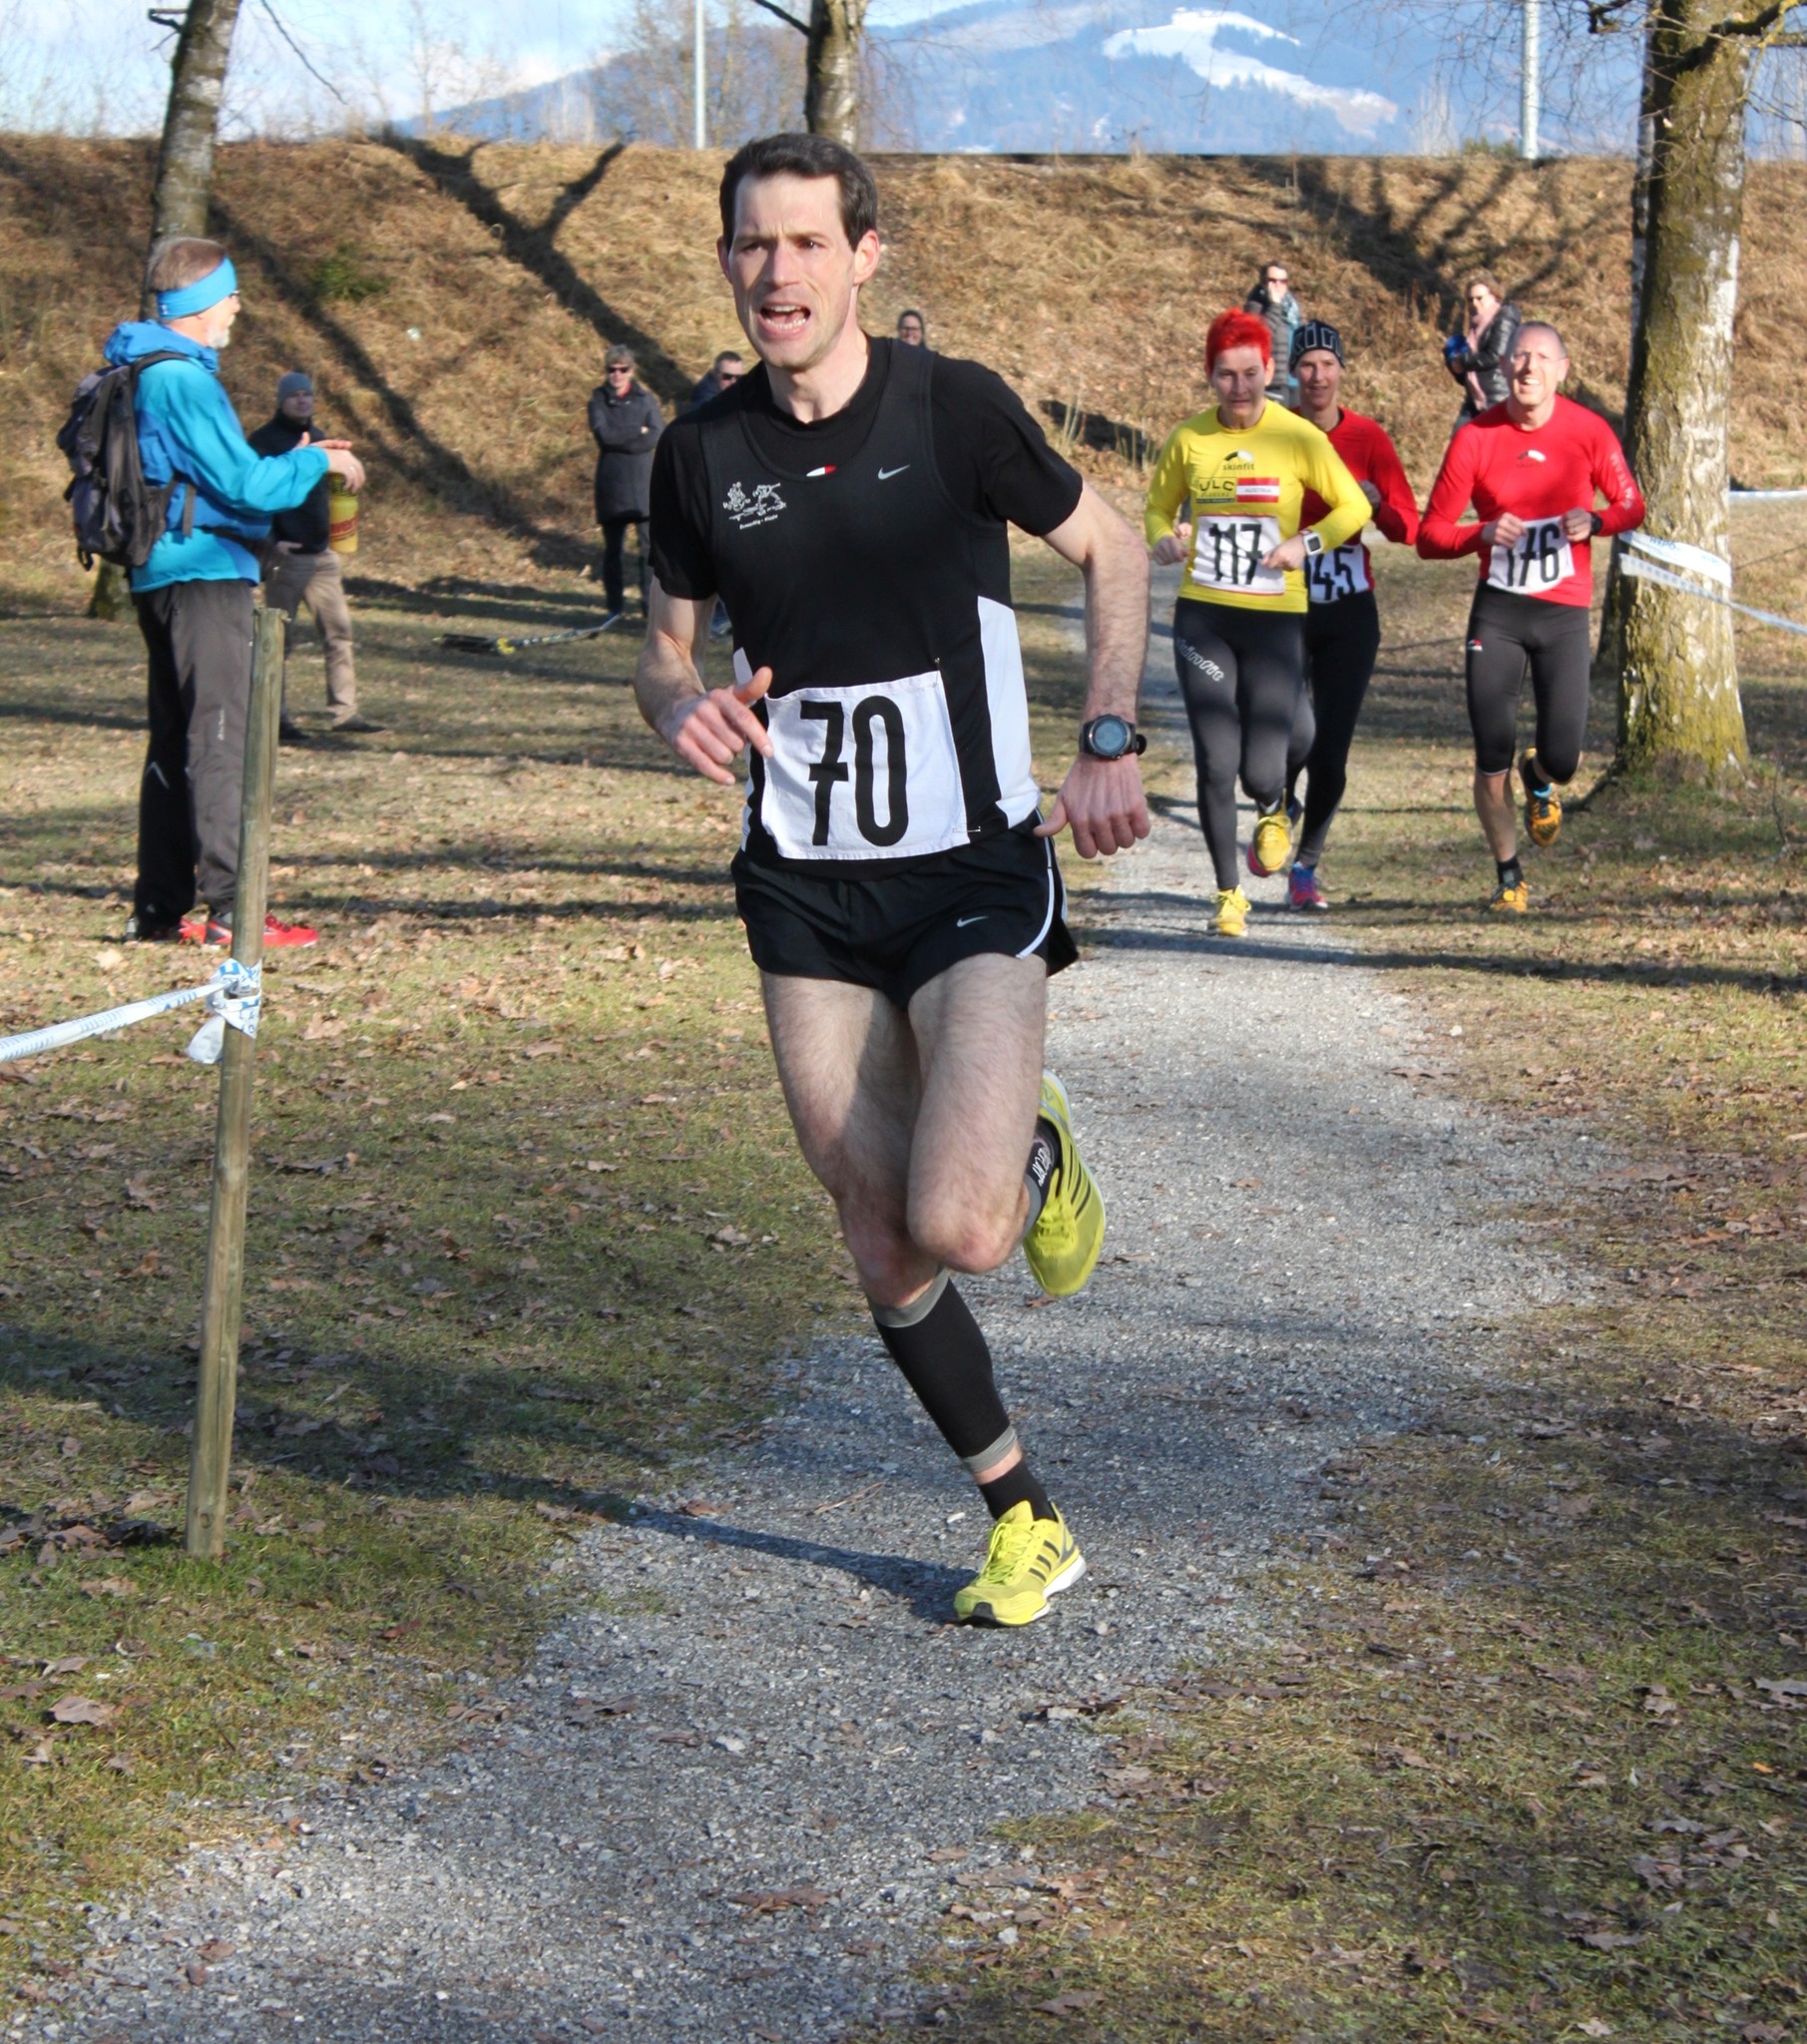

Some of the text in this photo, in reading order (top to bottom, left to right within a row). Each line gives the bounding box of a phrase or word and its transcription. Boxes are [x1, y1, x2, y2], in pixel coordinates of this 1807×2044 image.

[1198, 480, 1235, 492] ULC
[1222, 462, 1255, 471] skinfit
[1208, 522, 1263, 586] 117
[1506, 522, 1561, 588] 176
[799, 695, 909, 847] 70
